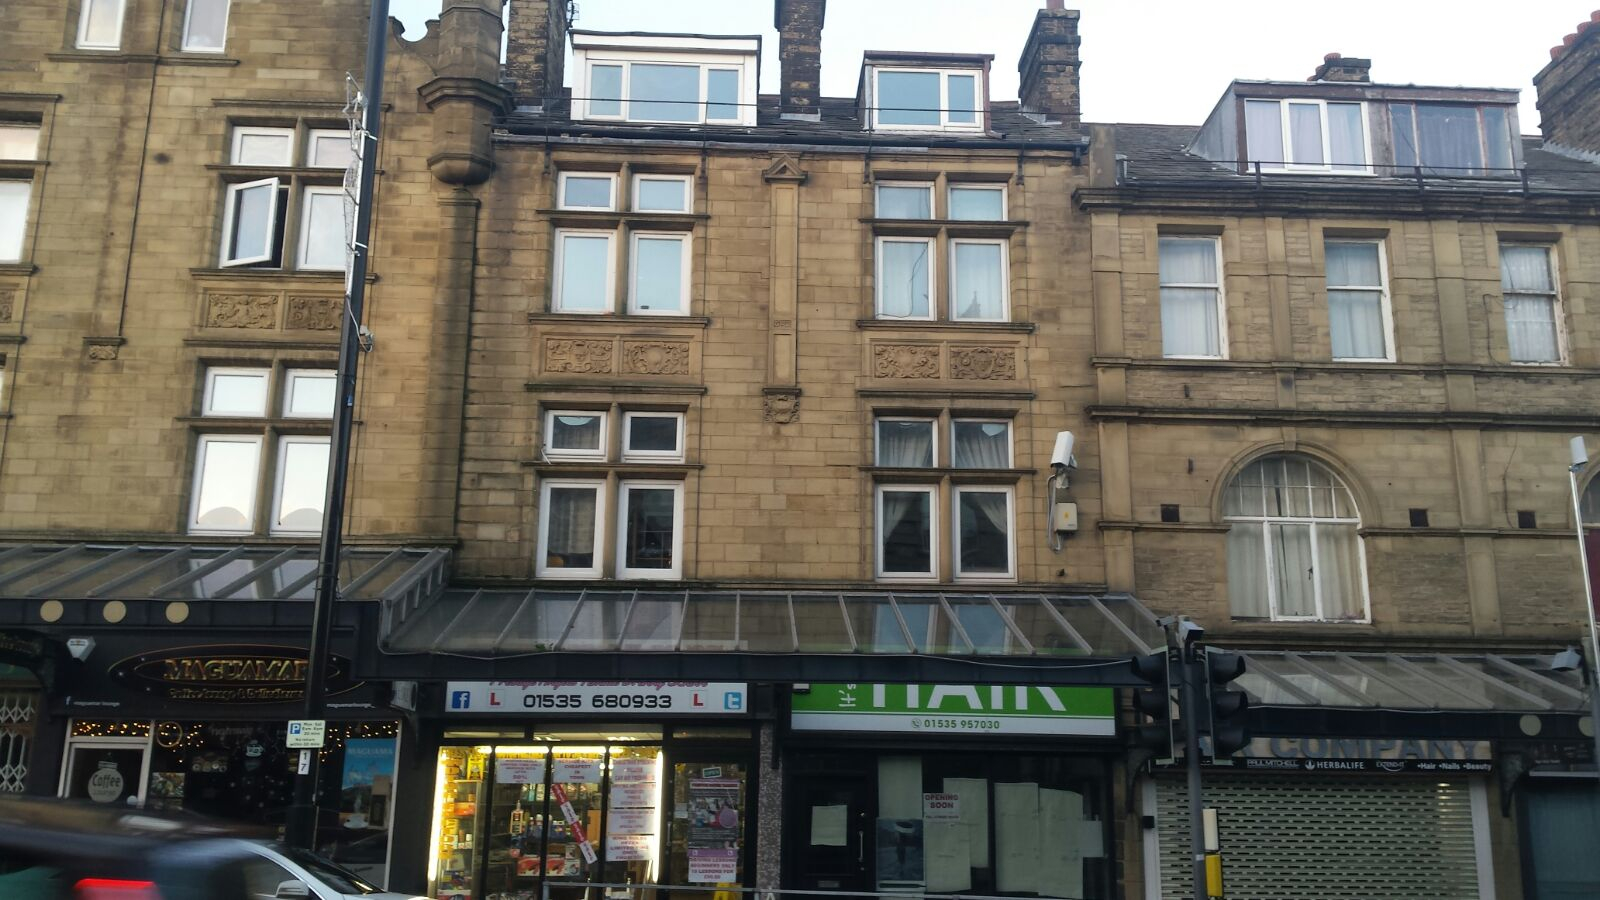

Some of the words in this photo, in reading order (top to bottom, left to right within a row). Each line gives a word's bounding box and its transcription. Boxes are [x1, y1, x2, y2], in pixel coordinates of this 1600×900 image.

[523, 694, 582, 708] 01535
[592, 694, 672, 709] 680933
[924, 718, 957, 729] 01535
[960, 719, 1000, 730] 957030
[1317, 761, 1365, 769] HERBALIFE
